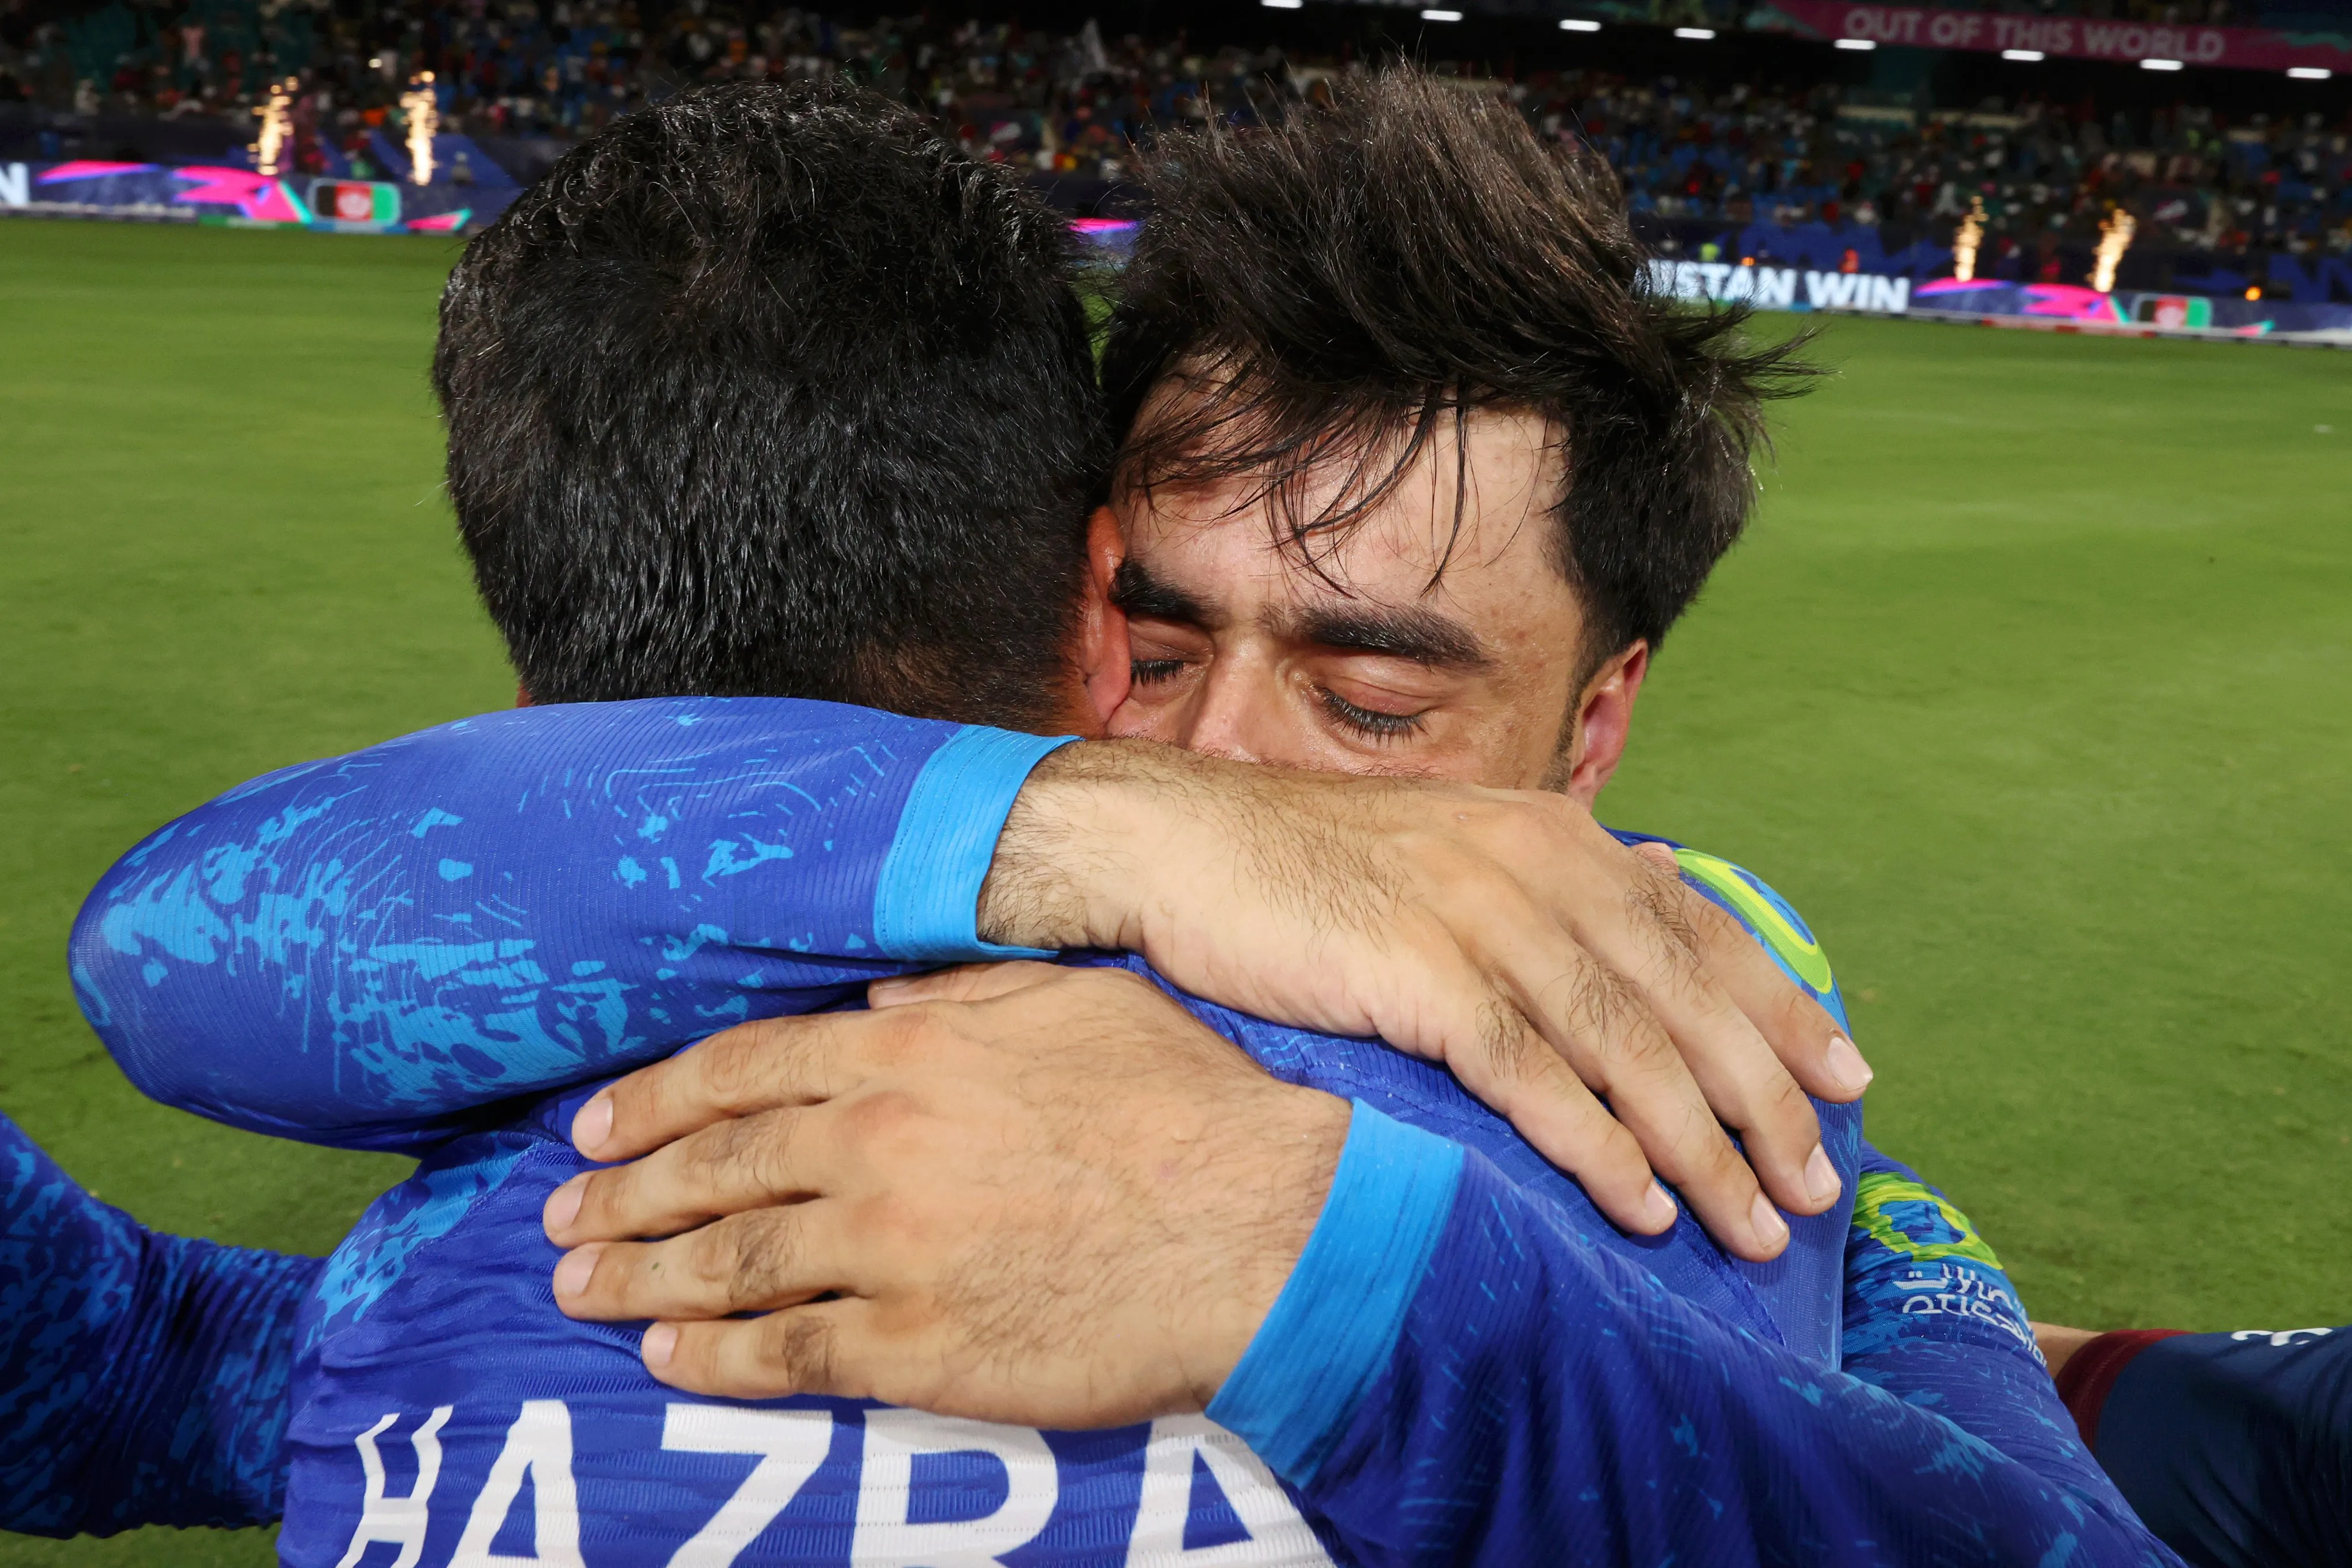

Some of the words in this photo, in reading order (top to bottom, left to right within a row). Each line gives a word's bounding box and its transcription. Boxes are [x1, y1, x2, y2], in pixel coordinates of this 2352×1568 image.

[1844, 8, 1924, 42] OUT
[1930, 14, 1983, 47] OF
[1992, 17, 2073, 54] THIS
[2082, 23, 2226, 61] WORLD
[1804, 270, 1910, 313] WIN
